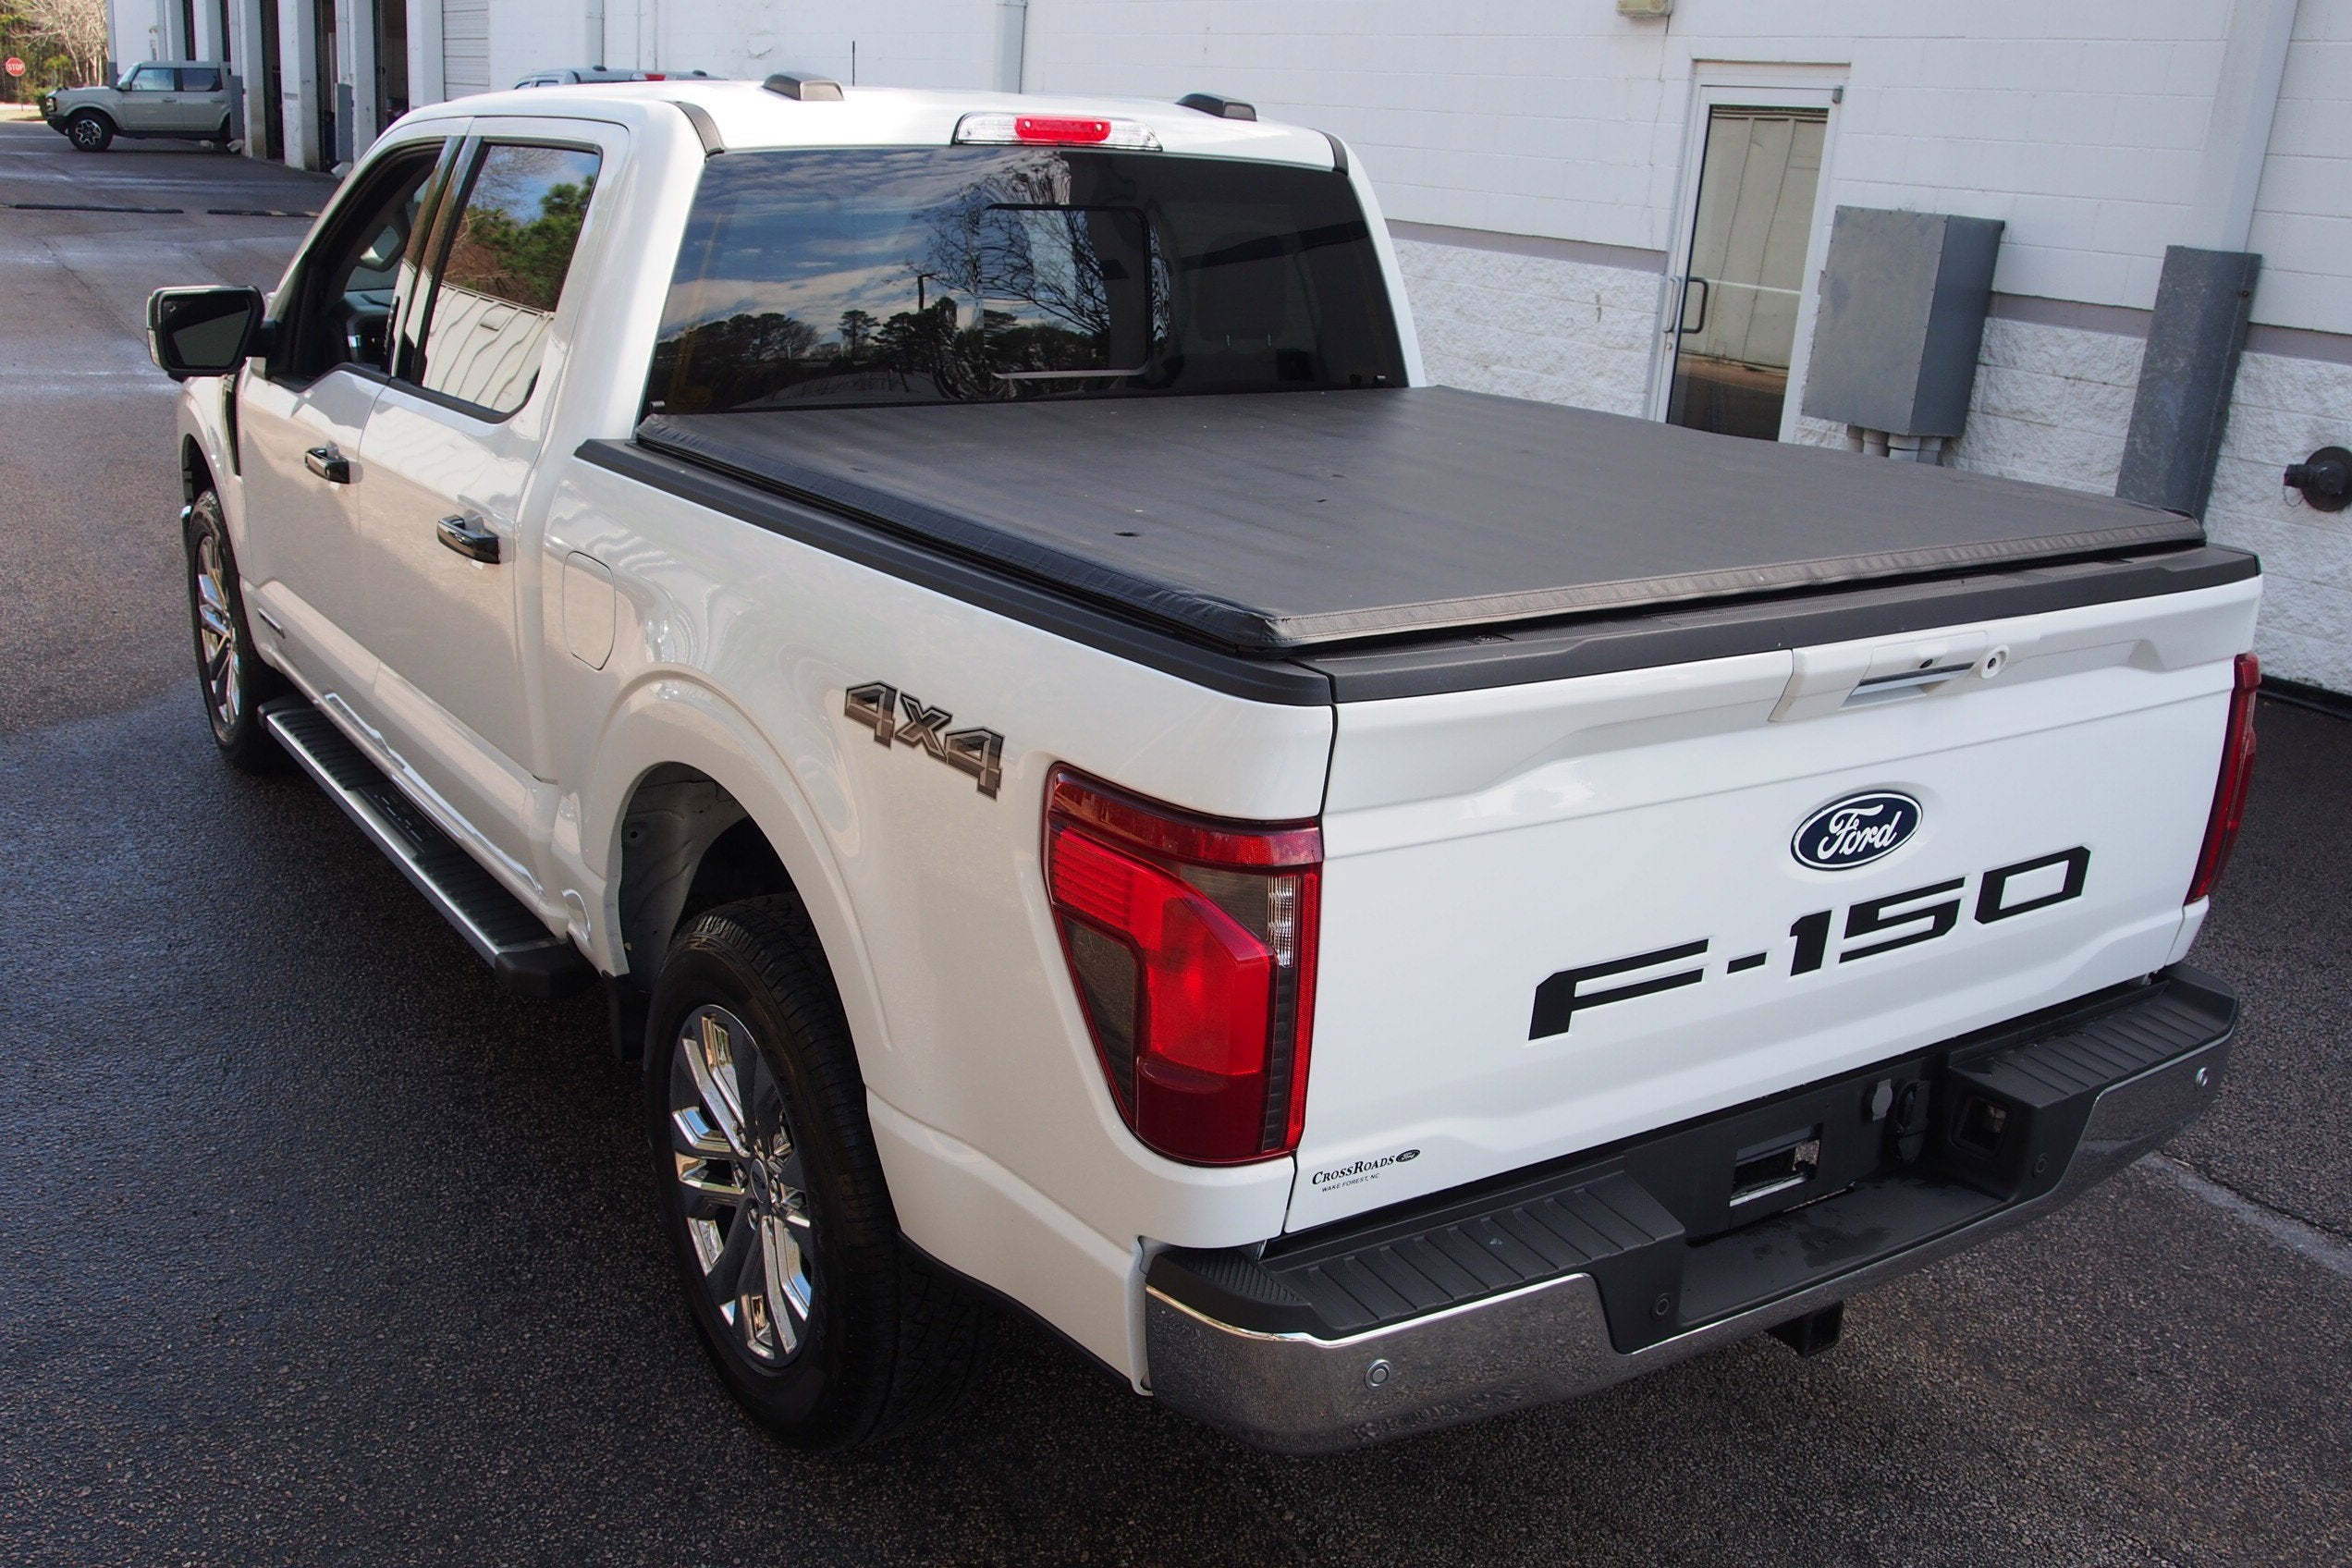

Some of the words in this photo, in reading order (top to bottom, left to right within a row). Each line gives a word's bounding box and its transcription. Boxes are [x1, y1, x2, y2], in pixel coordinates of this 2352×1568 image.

[7, 63, 24, 71] STOP
[1817, 803, 1902, 861] Ford
[1528, 845, 2091, 1041] F-150
[1321, 1182, 1341, 1193] WAKE
